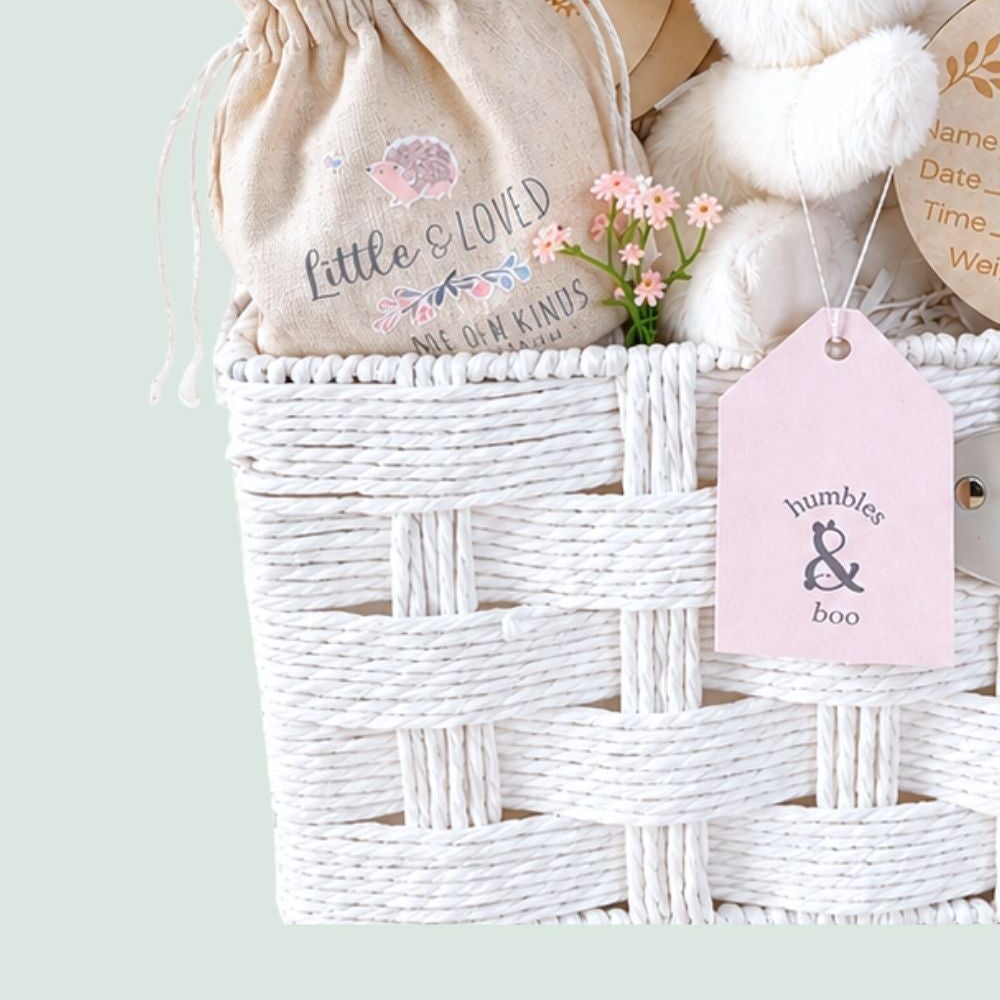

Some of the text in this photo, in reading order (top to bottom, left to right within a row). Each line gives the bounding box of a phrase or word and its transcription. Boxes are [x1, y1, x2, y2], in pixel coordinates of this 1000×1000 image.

[919, 158, 982, 190] Date
[923, 199, 988, 234] Time
[304, 177, 551, 301] Little & LOVED
[784, 486, 886, 526] humbles
[803, 519, 865, 594] &
[811, 601, 860, 626] boo
